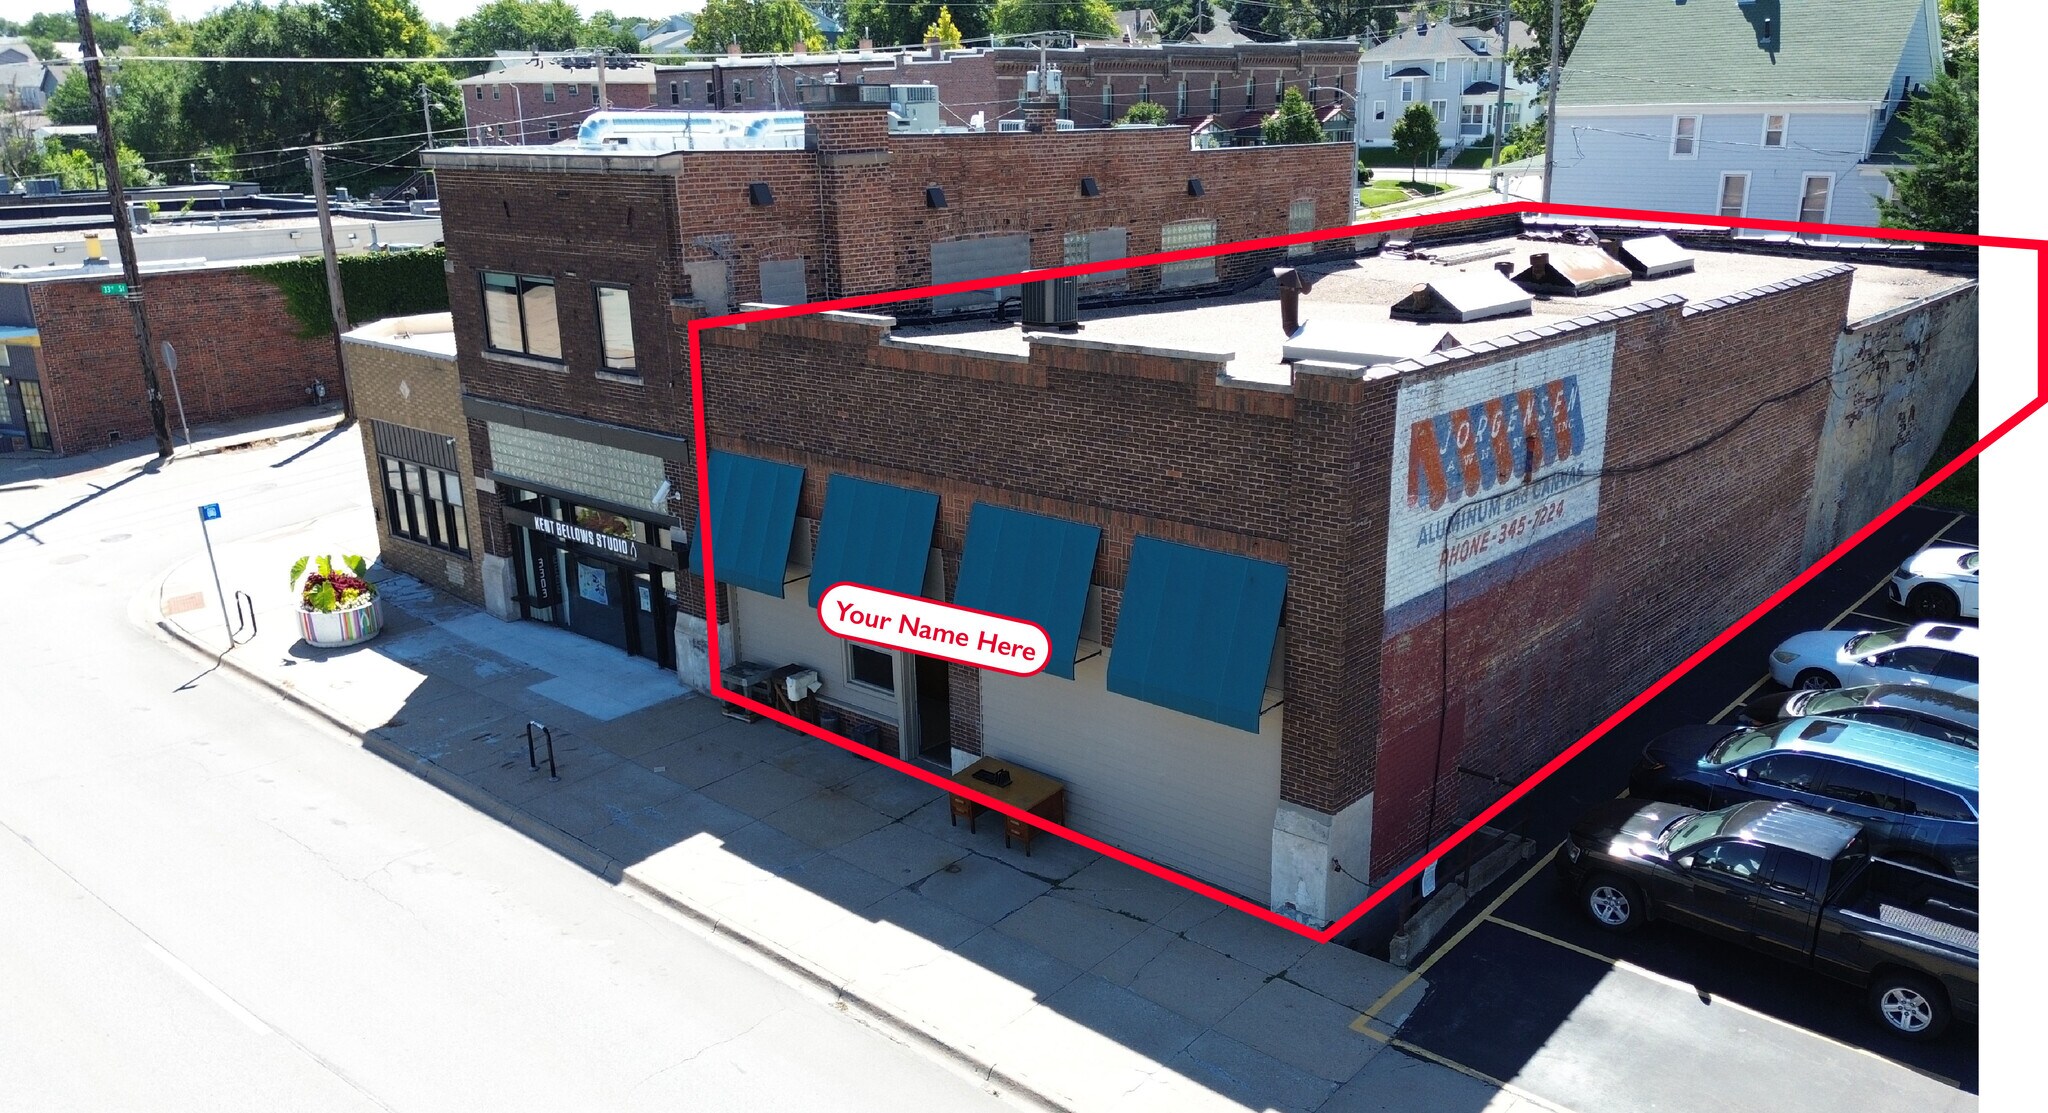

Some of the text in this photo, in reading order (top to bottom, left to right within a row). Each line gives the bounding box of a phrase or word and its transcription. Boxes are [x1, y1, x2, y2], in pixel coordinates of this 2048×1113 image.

[1439, 385, 1578, 455] JORGENSEN
[1556, 418, 1575, 434] INC
[1416, 463, 1584, 549] ALUMINUM and CANVAS
[534, 516, 628, 555] KENT BELLOWS STUDIO
